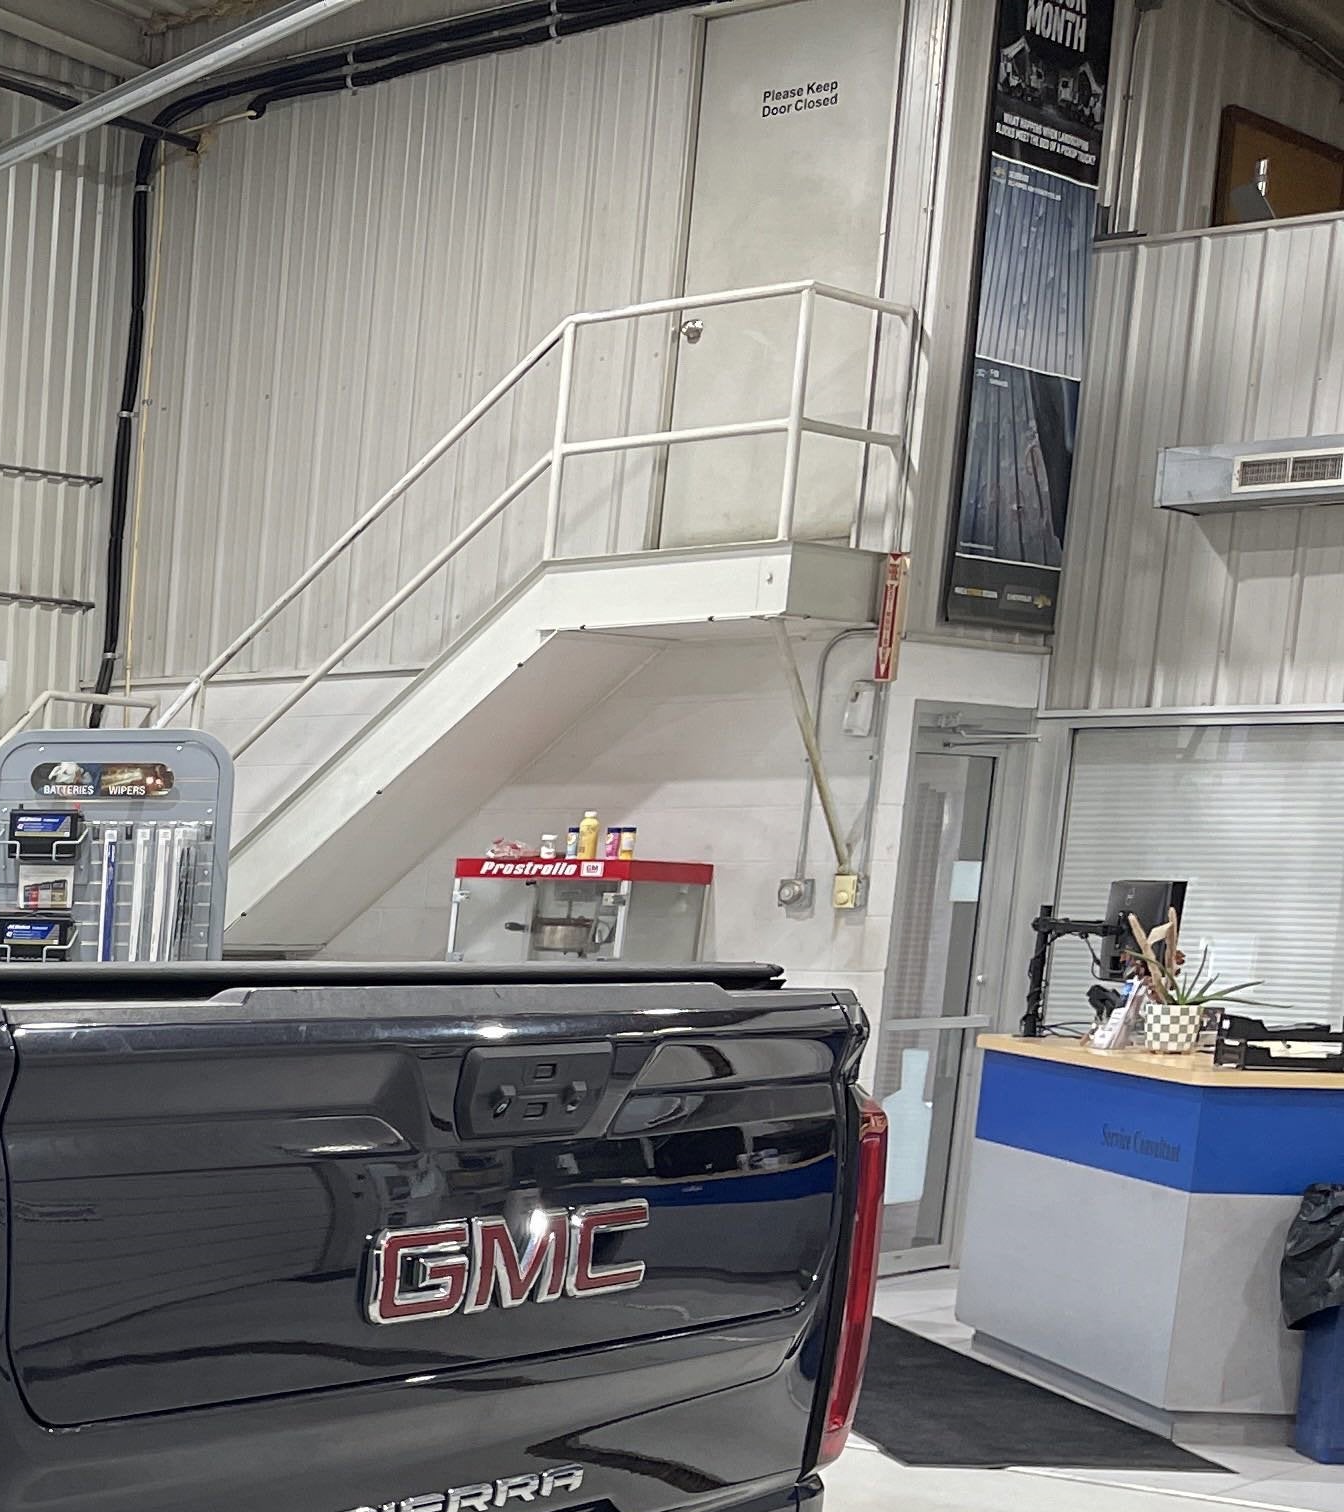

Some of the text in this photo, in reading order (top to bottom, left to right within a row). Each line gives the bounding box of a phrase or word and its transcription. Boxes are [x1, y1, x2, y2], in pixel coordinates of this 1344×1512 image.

[1026, 2, 1087, 52] MONTH
[763, 81, 838, 103] Please Keep
[762, 93, 838, 117] Door Closed
[43, 785, 146, 796] BATTERIES WIPERS
[479, 861, 578, 876] Prostrollo
[365, 1198, 649, 1325] GMC
